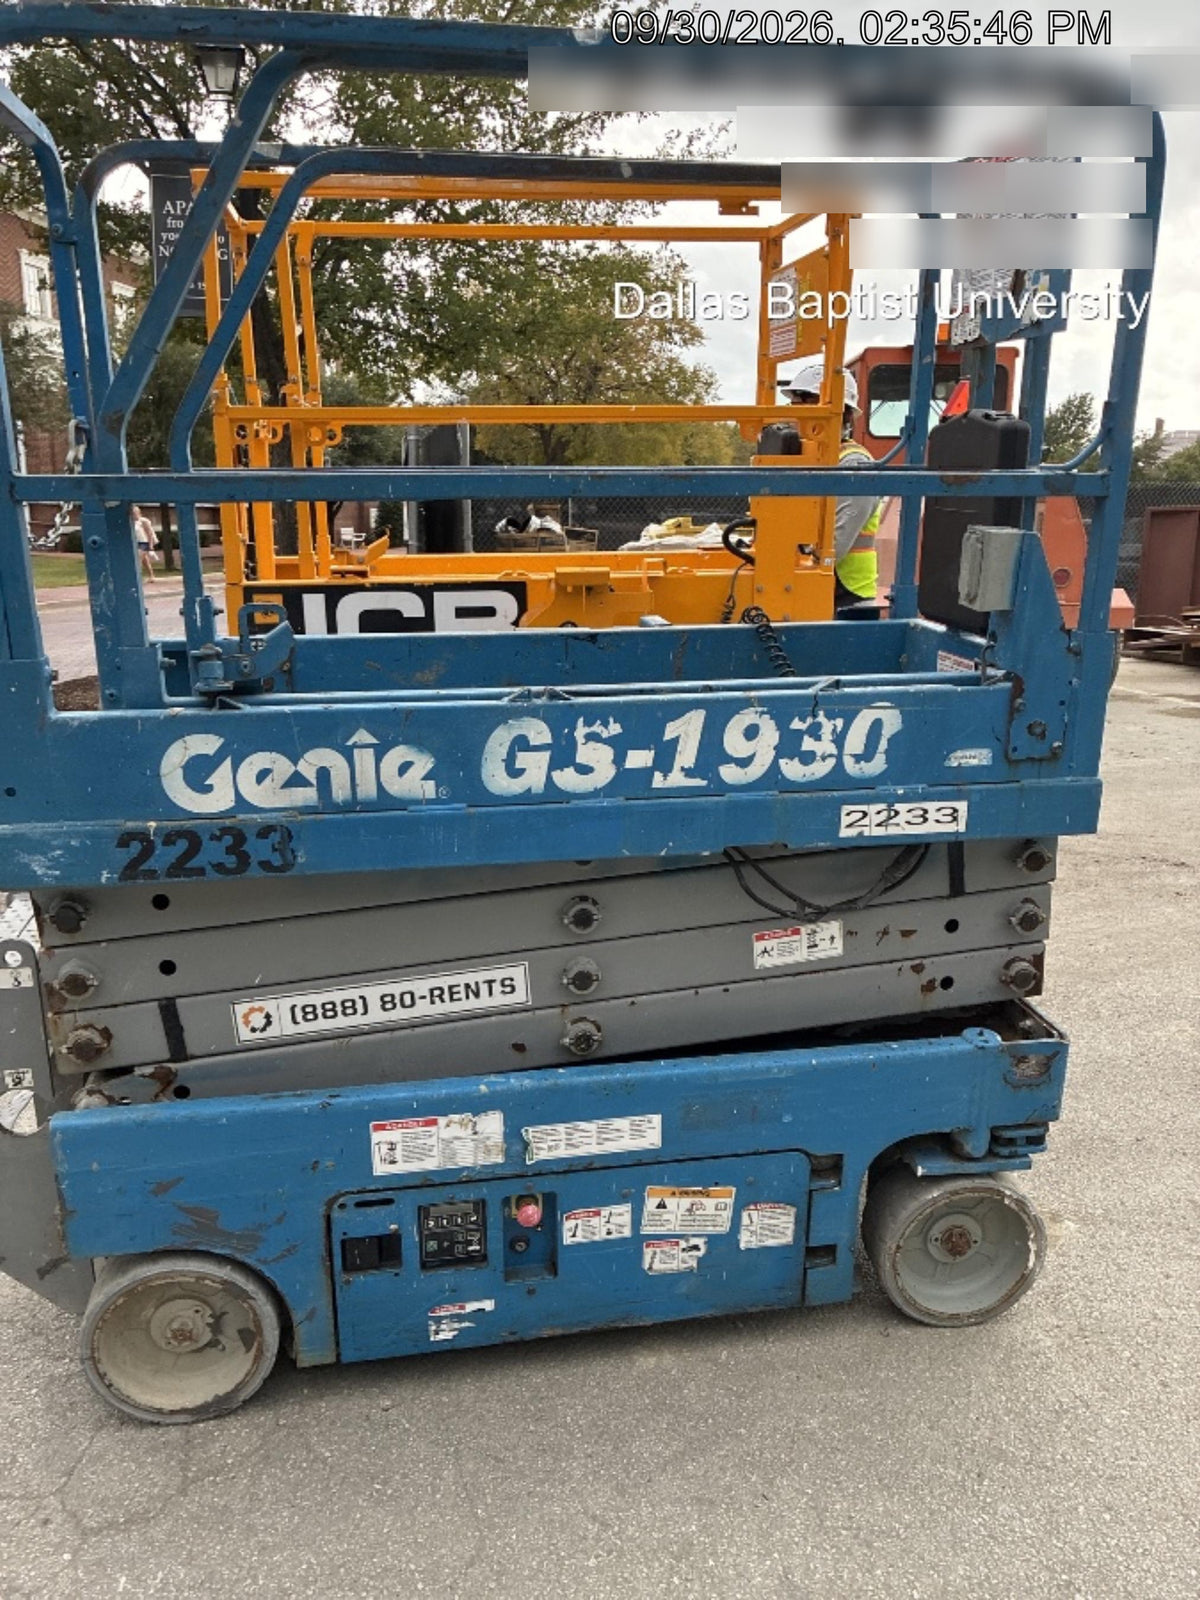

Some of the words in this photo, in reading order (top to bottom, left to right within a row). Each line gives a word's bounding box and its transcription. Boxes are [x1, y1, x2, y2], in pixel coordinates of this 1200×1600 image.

[160, 728, 436, 813] Genie
[480, 702, 902, 796] GS-1930
[842, 806, 959, 829] 2233
[115, 824, 296, 882] 2233
[290, 995, 369, 1025] (888)
[379, 976, 517, 1013] 80-RENTS
